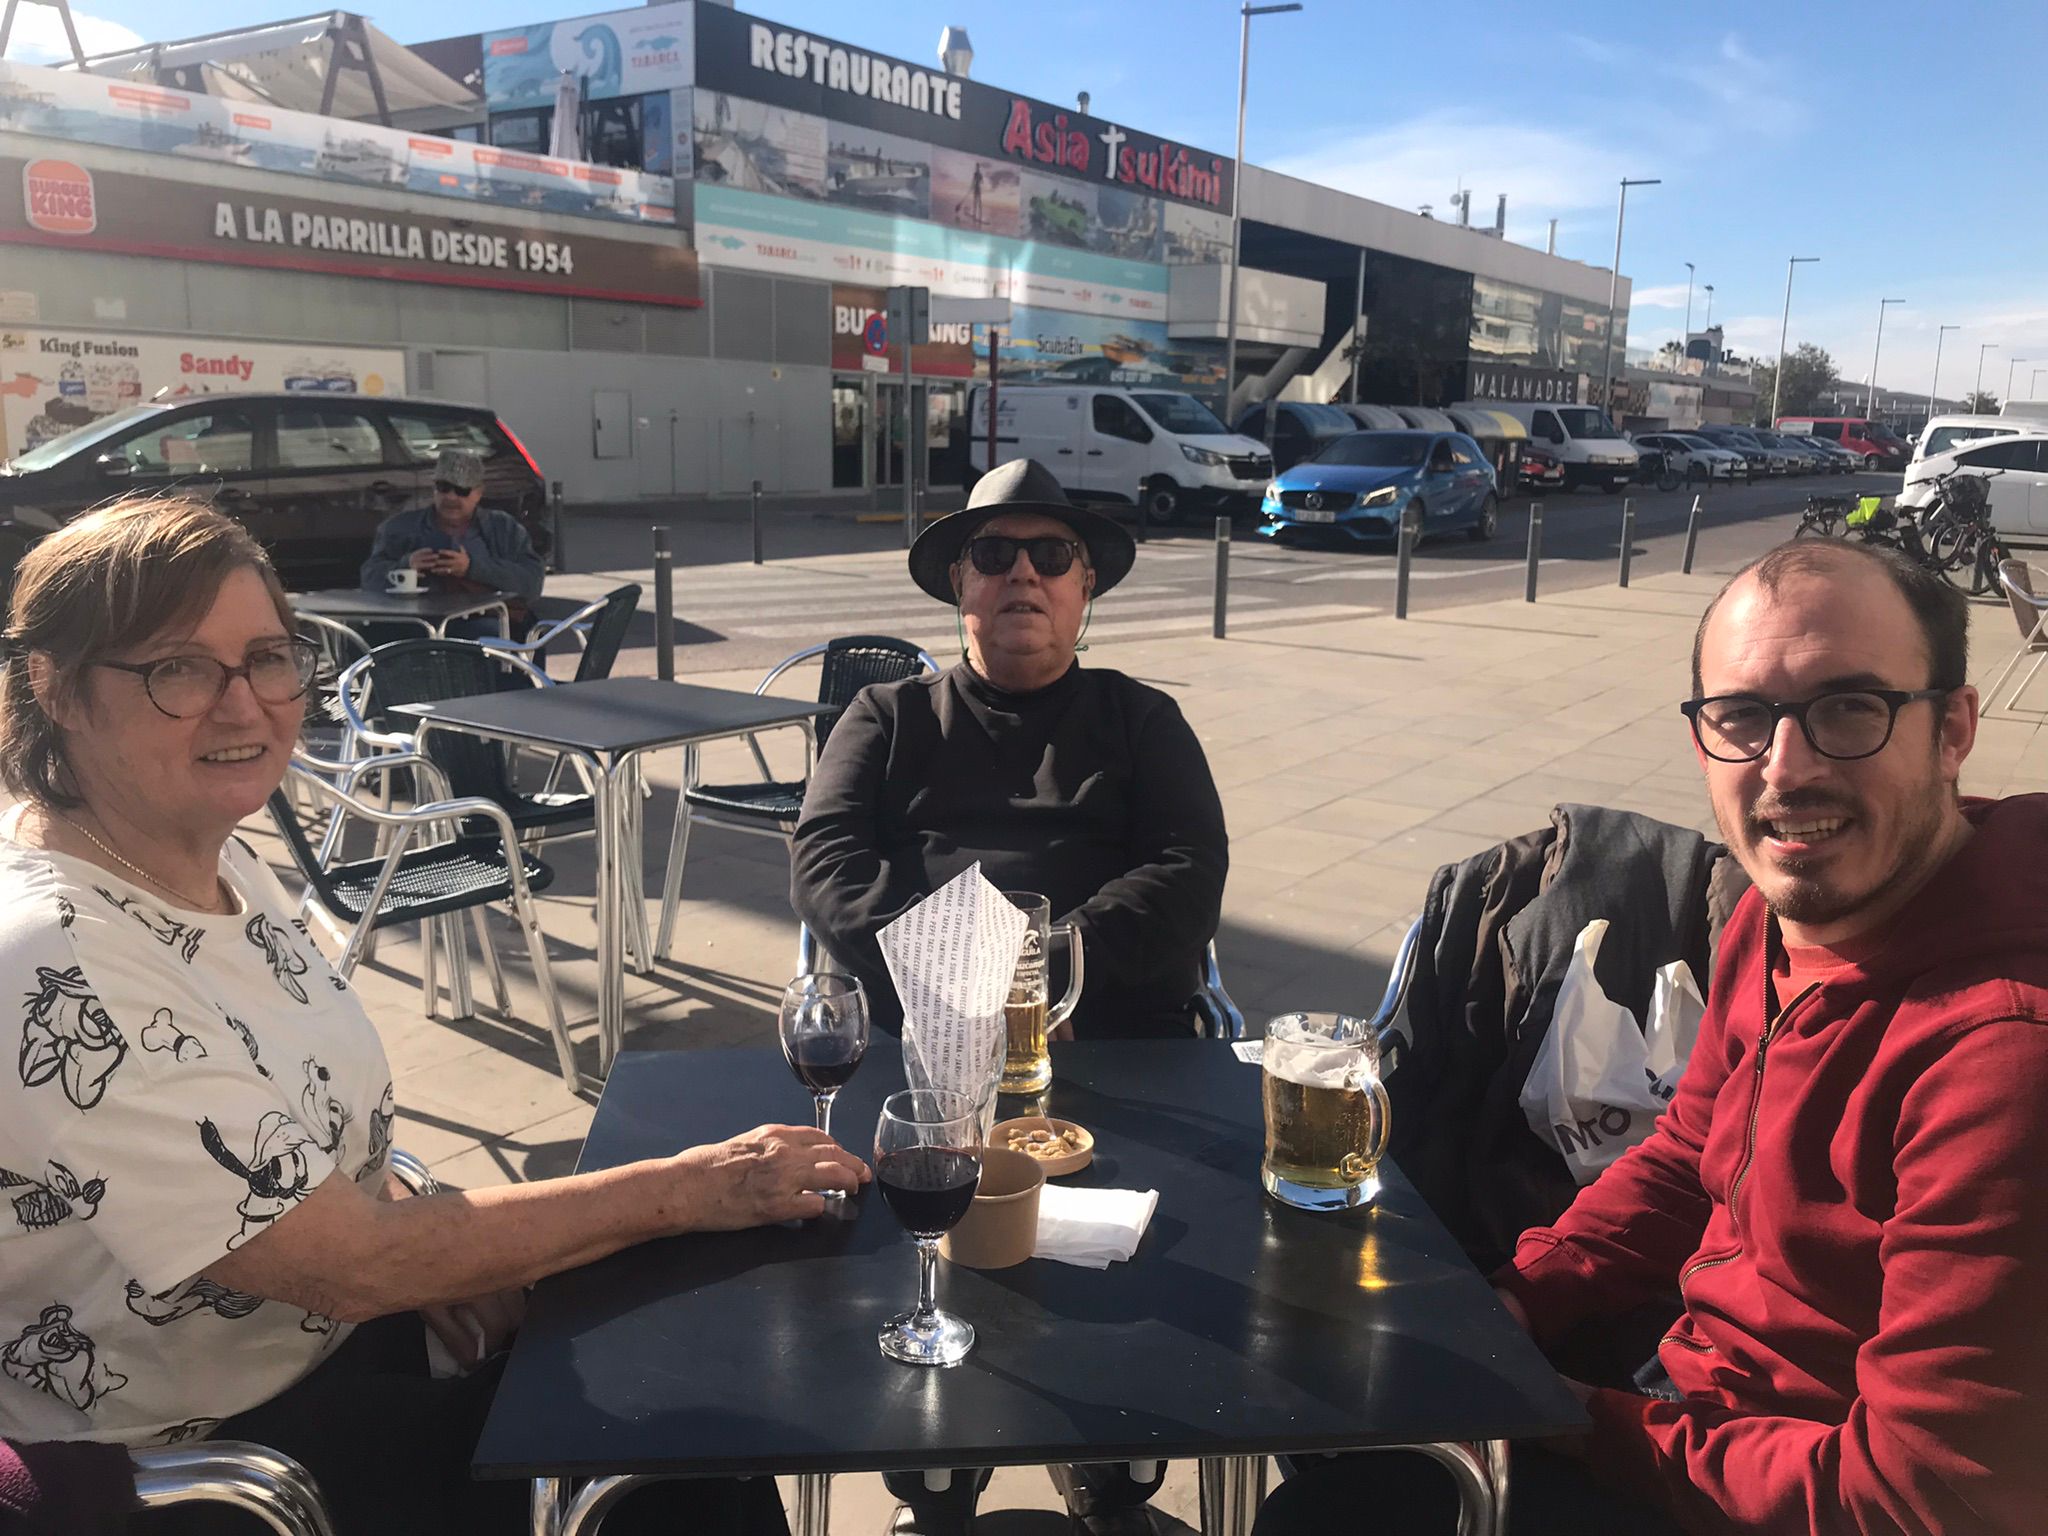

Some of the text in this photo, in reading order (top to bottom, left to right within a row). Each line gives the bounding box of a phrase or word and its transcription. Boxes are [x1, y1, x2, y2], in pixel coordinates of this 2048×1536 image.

[751, 23, 962, 120] RESTAURANTE
[1003, 99, 1090, 172] Asia
[28, 179, 91, 198] BURGER
[31, 192, 93, 218] KING
[215, 202, 576, 275] A LA PARRILLA DESDE 1954
[40, 336, 82, 358] King
[84, 341, 139, 358] Fusion
[179, 352, 254, 381] Sandy
[1473, 371, 1572, 402] MALAMADRE
